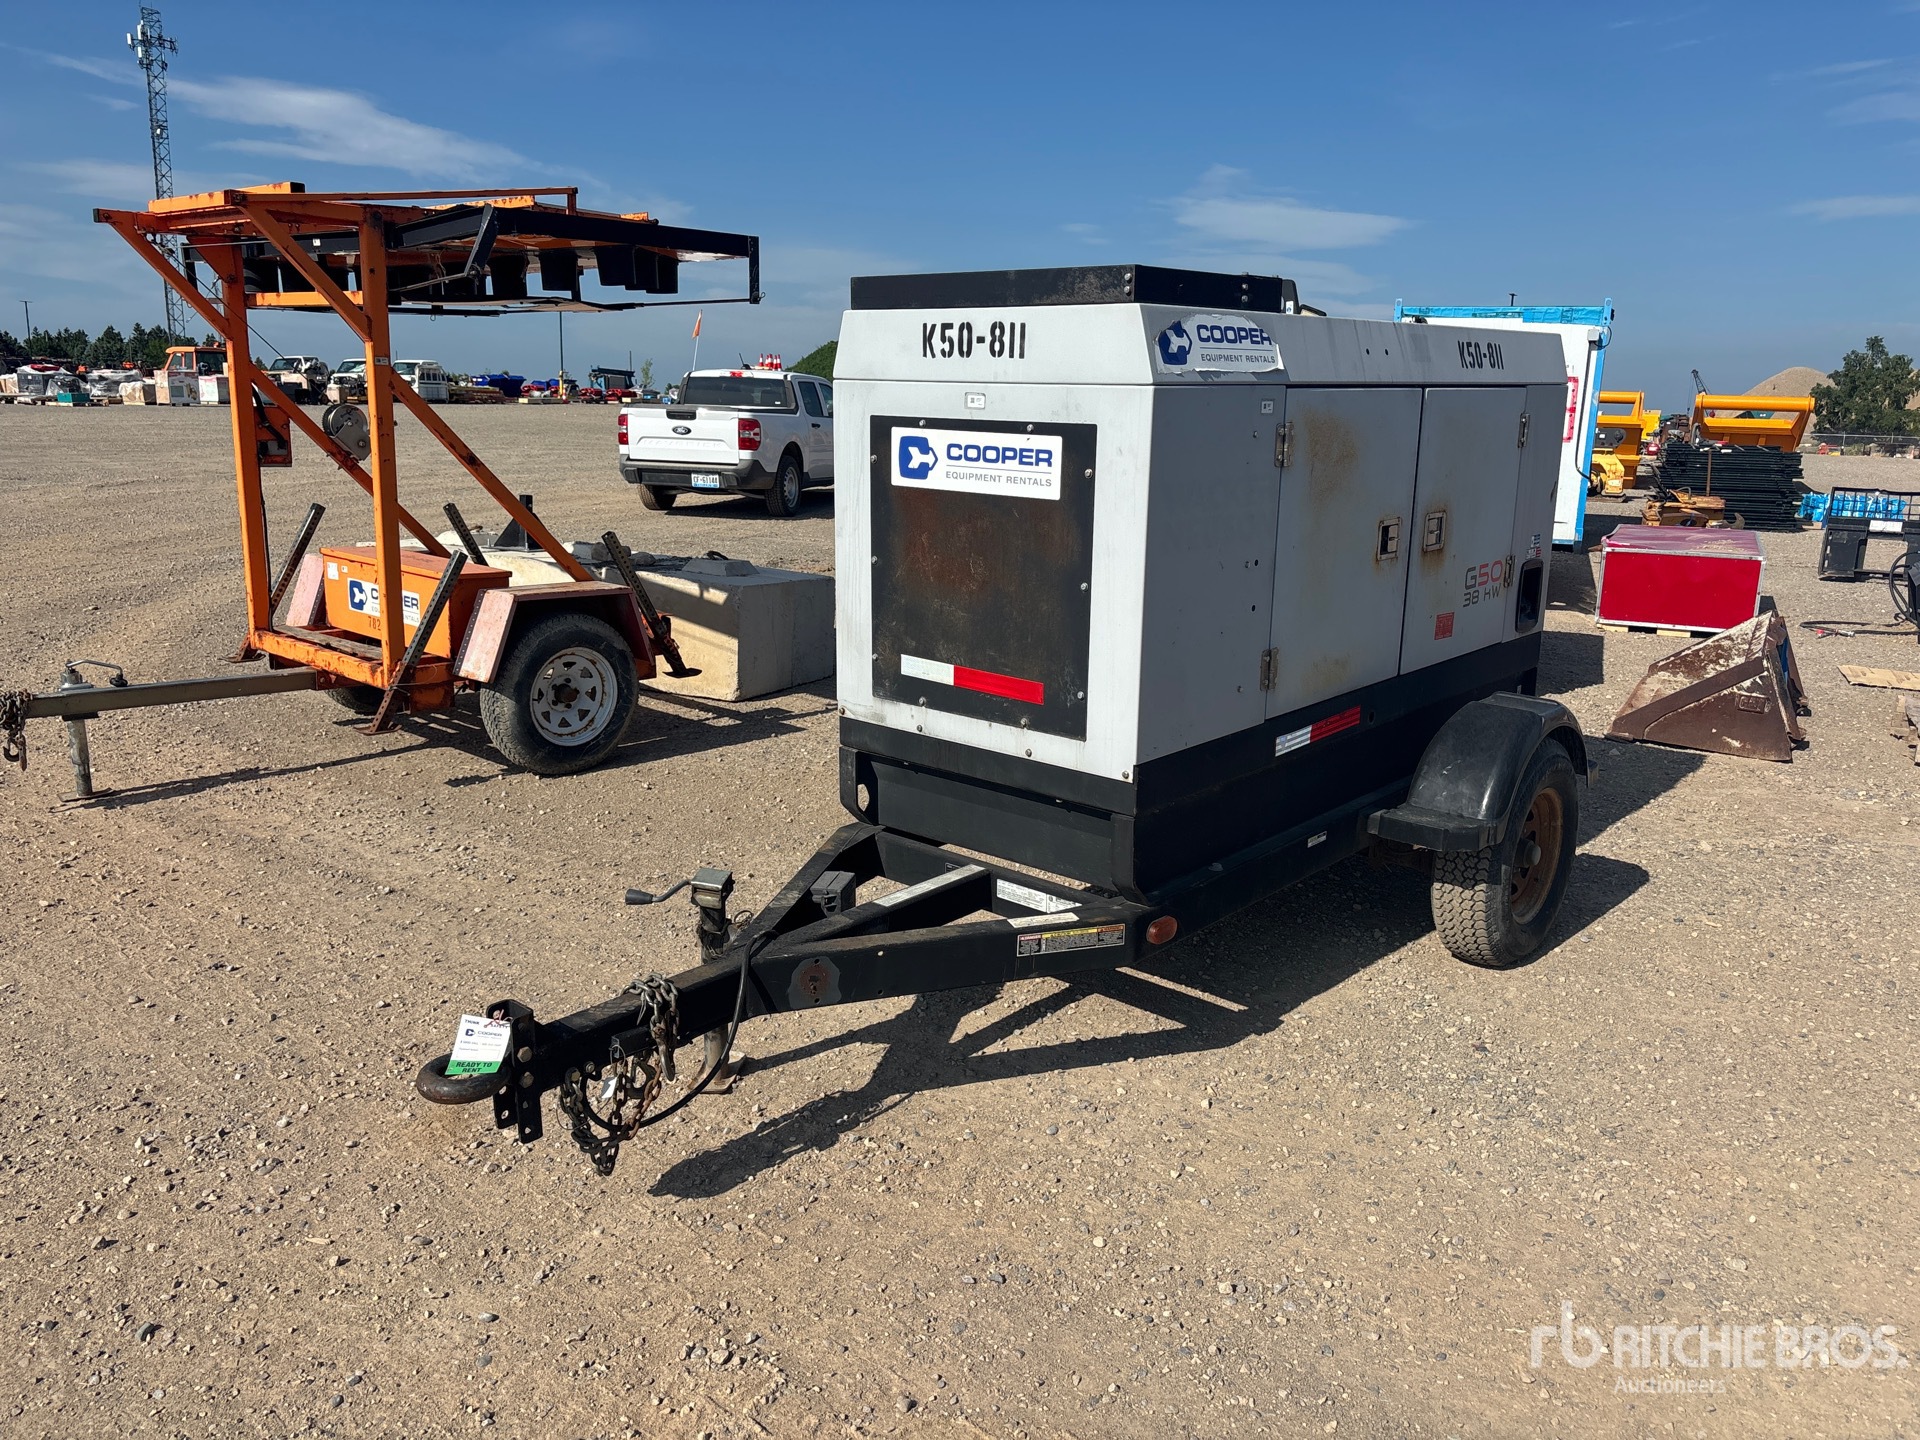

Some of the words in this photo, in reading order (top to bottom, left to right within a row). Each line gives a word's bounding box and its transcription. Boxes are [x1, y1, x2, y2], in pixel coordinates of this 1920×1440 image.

[922, 320, 1026, 359] K50-811
[1200, 353, 1244, 363] EQUIPMENT
[1245, 354, 1276, 364] RENTALS
[1457, 340, 1504, 370] K50-811
[946, 443, 1053, 468] COOPER
[945, 471, 1003, 483] EQUIPMENT
[1006, 476, 1053, 487] RENTALS
[1464, 560, 1503, 590] G50
[1463, 590, 1480, 607] 38
